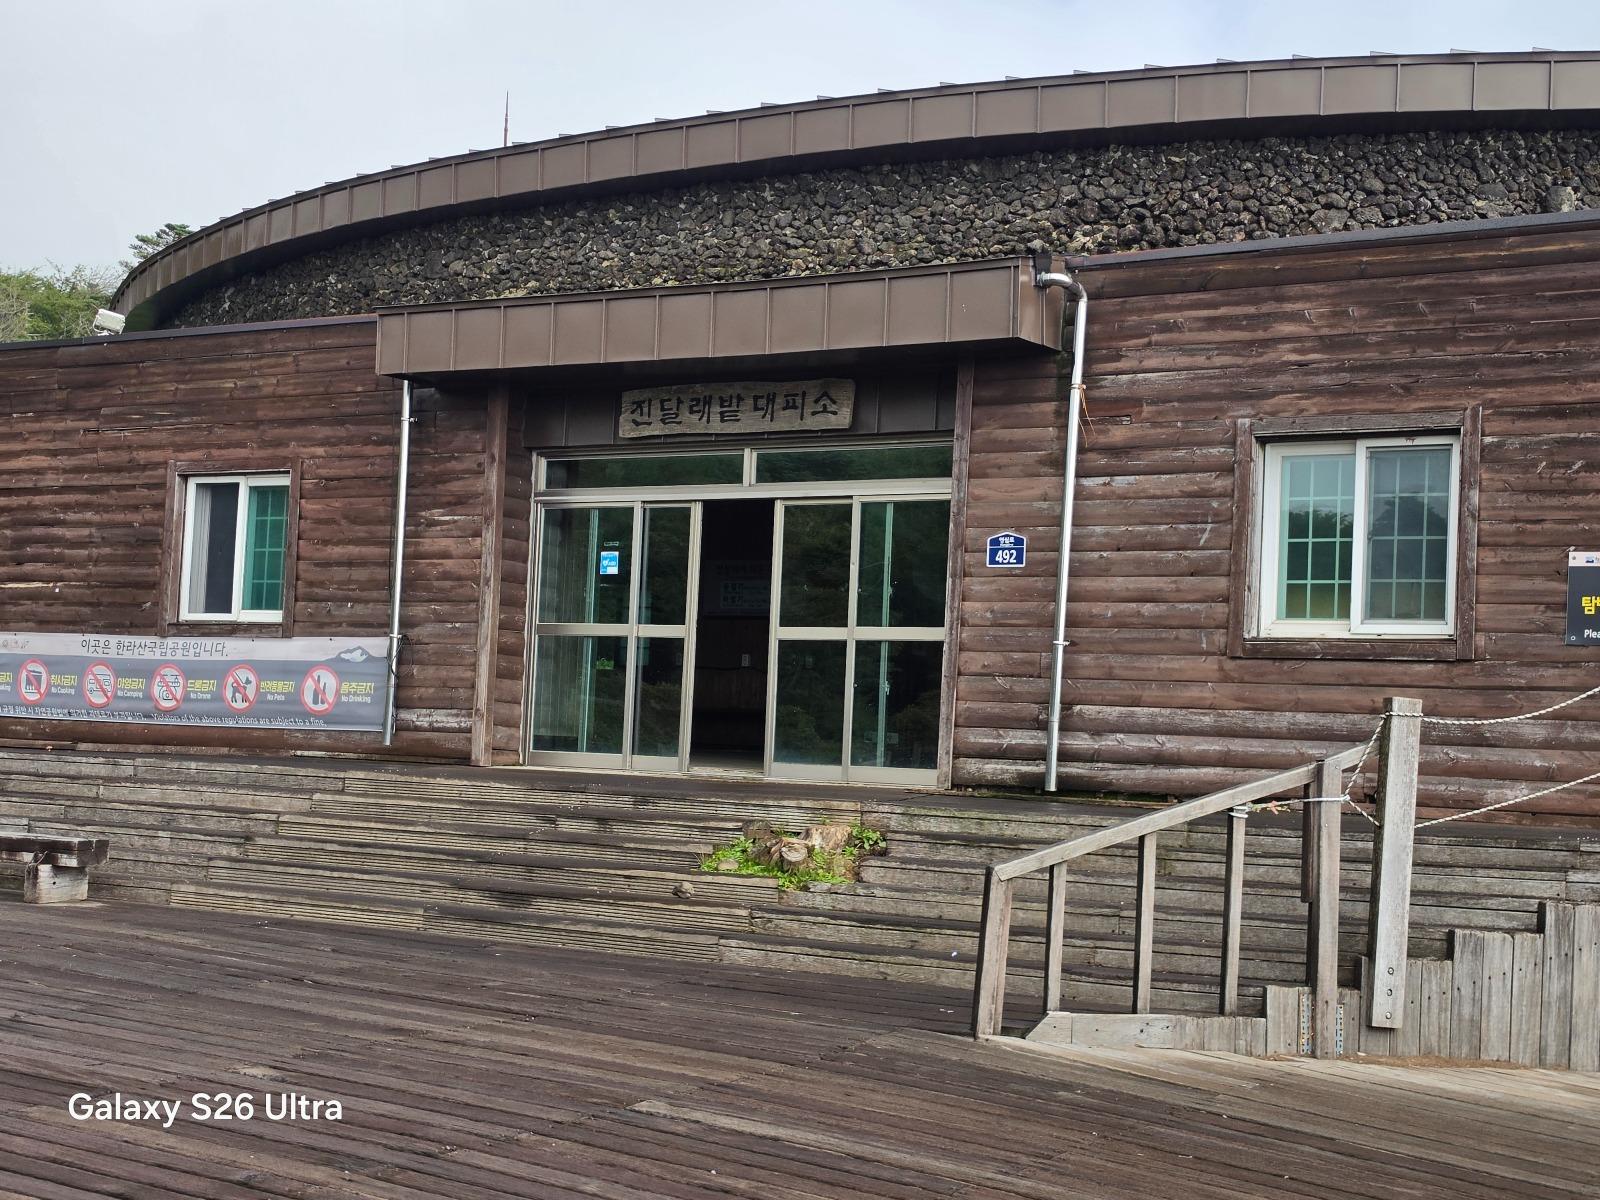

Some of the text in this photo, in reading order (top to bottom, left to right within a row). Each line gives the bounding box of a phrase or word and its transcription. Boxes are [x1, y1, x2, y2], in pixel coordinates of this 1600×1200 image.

[995, 549, 1017, 563] 492
[1581, 595, 1600, 615] 탐
[81, 638, 228, 657] 이곳은 한라산국립공원입니다.
[51, 675, 78, 686] 취사금지
[117, 677, 146, 690] 야영금지
[187, 679, 217, 692] 드론금지
[260, 681, 295, 693] 반려동물금지
[340, 682, 375, 694] 음주금지
[124, 690, 143, 698] Camping
[267, 693, 273, 701] No
[348, 695, 371, 703] Drinking
[181, 713, 188, 722] of
[189, 714, 200, 723] the
[202, 714, 221, 723] above
[222, 715, 258, 725] regulations
[259, 717, 270, 725] are
[271, 717, 296, 727] subject
